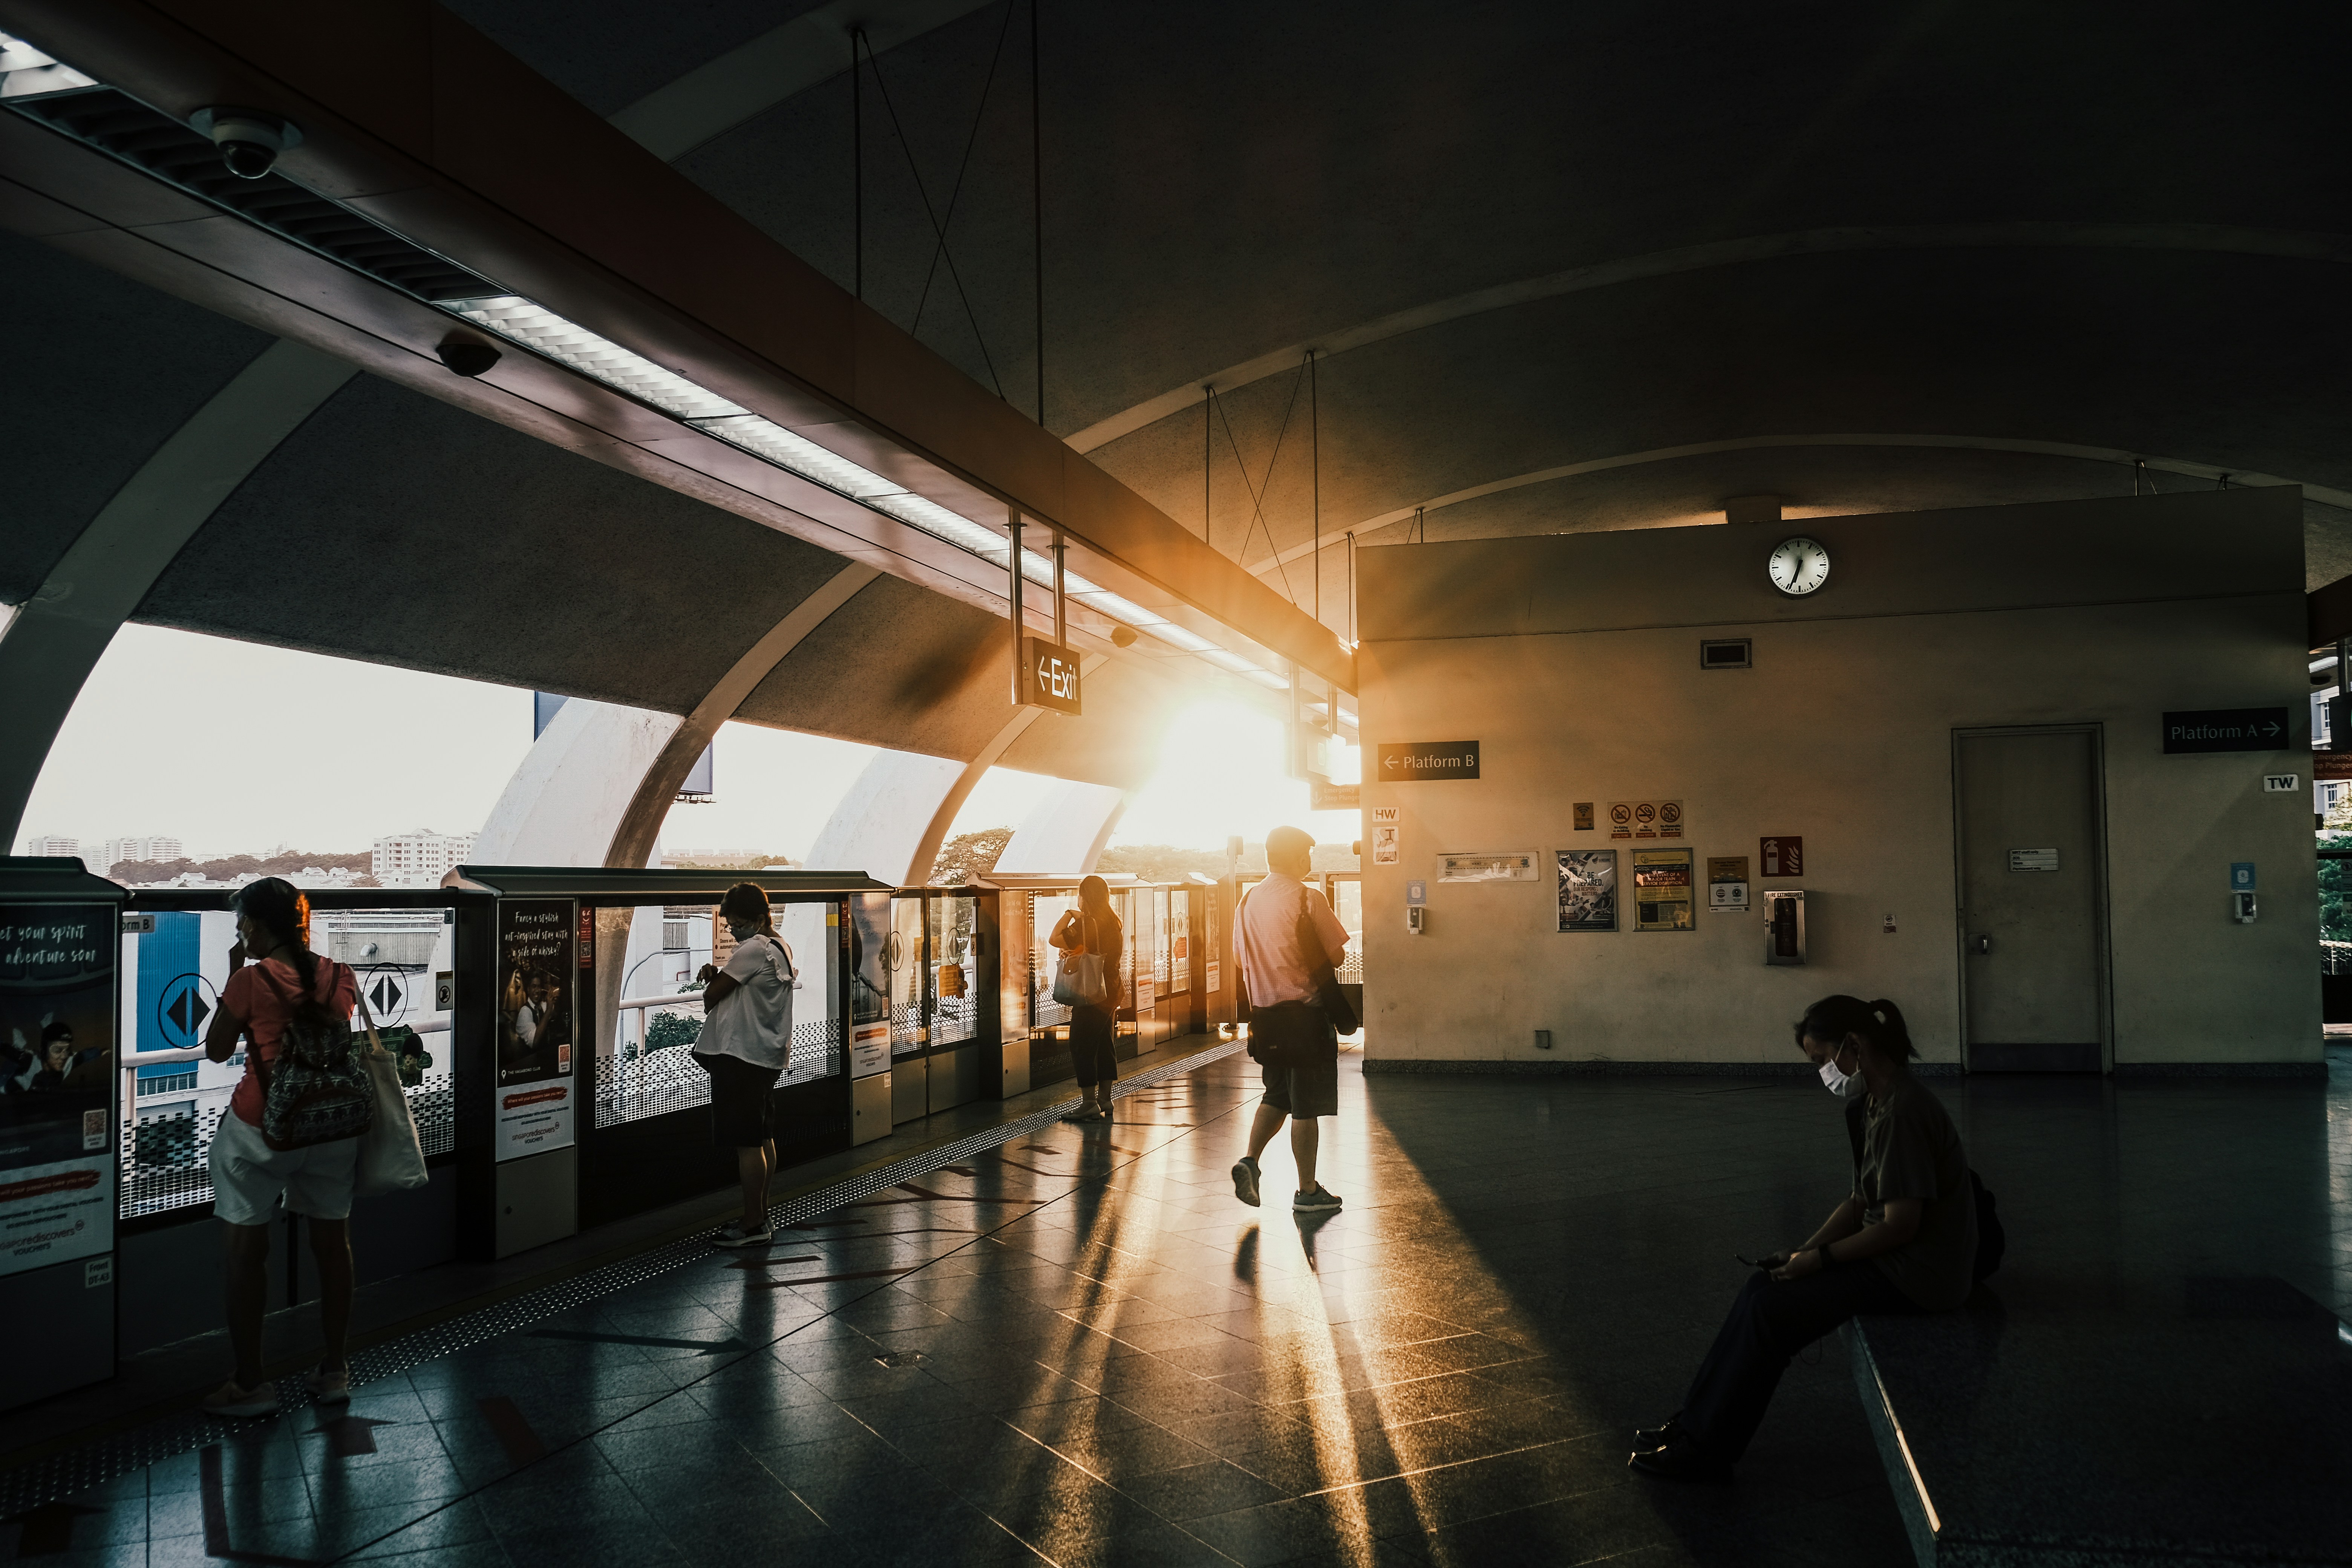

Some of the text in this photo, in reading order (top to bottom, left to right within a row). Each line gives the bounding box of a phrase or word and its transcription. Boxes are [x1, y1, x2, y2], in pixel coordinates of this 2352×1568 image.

[1051, 658, 1078, 701] Exit
[2171, 724, 2258, 740] Platform A
[1404, 755, 1474, 769] Platform B
[2267, 777, 2294, 789] TW
[1375, 809, 1396, 819] HW
[143, 919, 150, 929] B
[447, 913, 451, 922] 3
[515, 911, 532, 924] Fancy
[539, 912, 559, 923] stylish
[0, 924, 88, 944] et your spirit
[505, 928, 541, 943] art-inspired
[542, 930, 554, 941] stay
[555, 929, 568, 941] with
[5, 946, 97, 966] adventure soar
[518, 945, 530, 957] side
[531, 945, 538, 956] of
[539, 942, 561, 957] whisky?
[0, 1146, 30, 1155] NGAPORE
[26, 1183, 52, 1193] passions
[89, 1262, 108, 1273] Front
